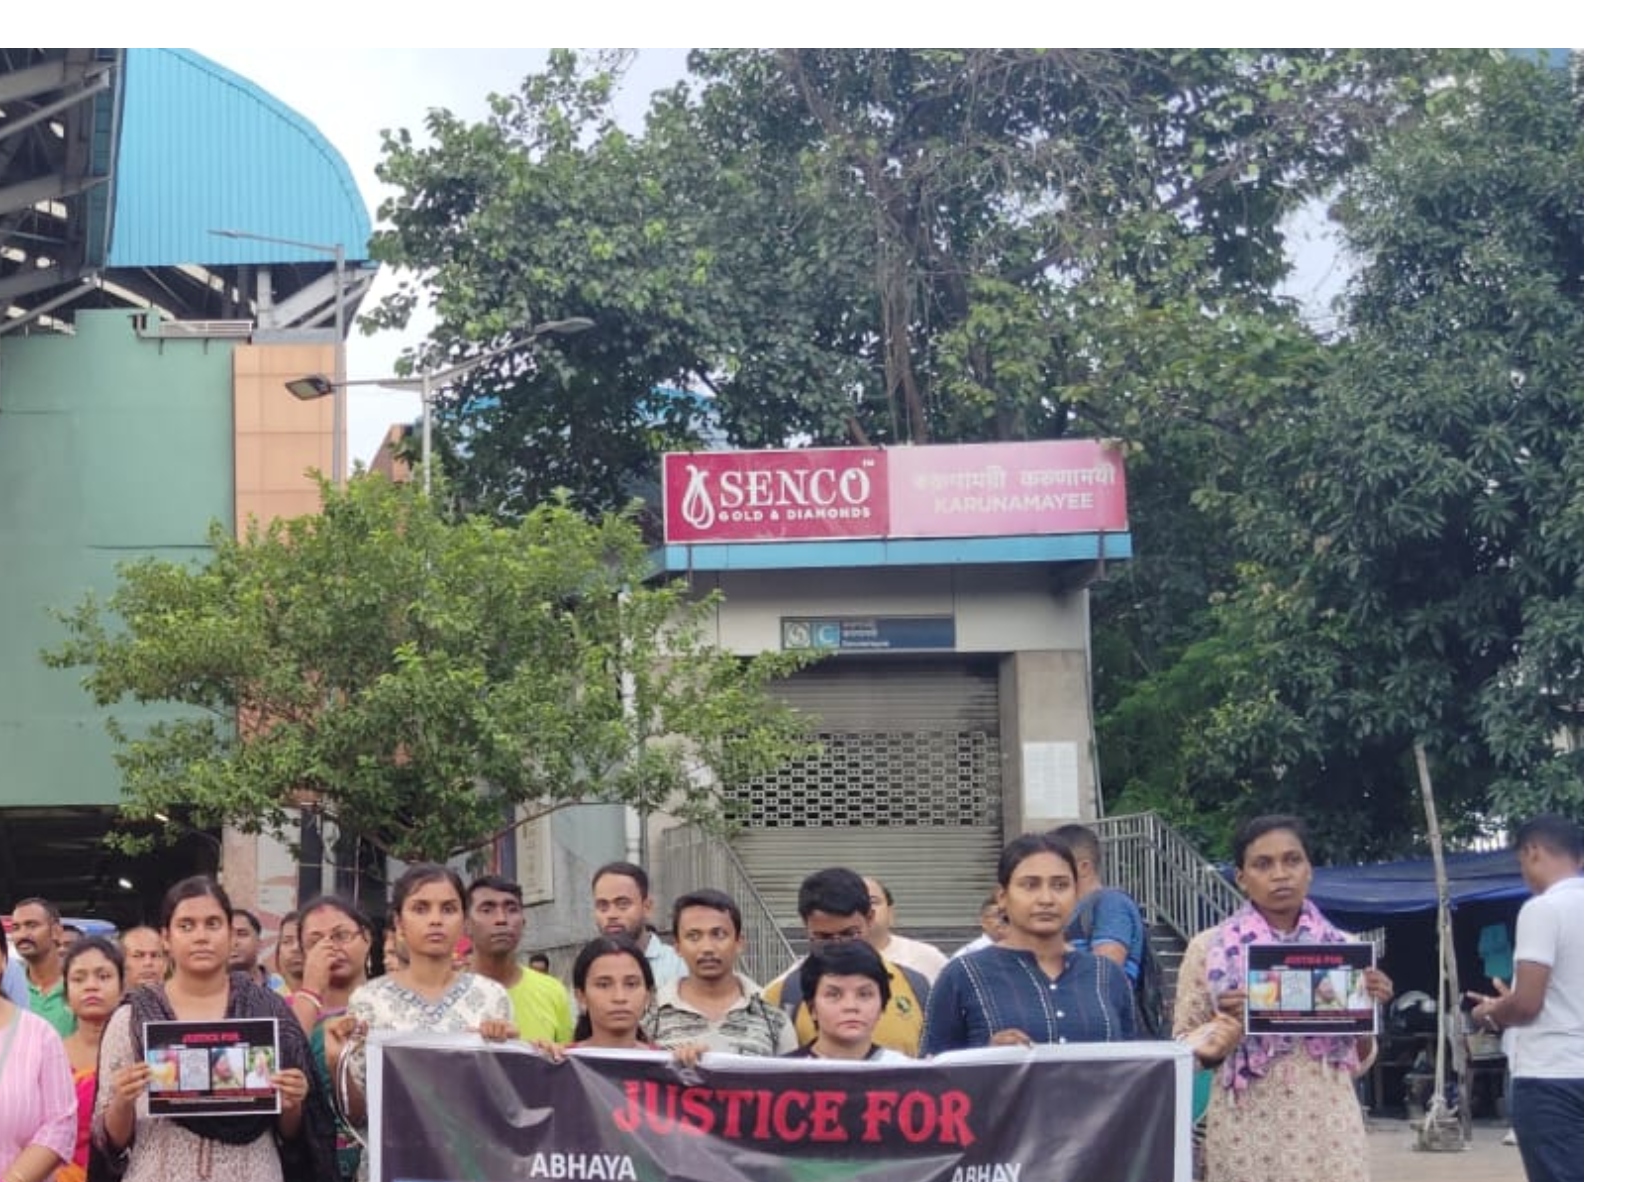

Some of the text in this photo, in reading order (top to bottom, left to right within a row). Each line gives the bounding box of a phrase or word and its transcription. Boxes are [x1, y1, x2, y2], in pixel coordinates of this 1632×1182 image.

[720, 467, 870, 508] SENCO
[718, 506, 872, 522] GOLD & DIAMONDS
[934, 492, 1094, 514] KARUNAMAYEE
[613, 1080, 976, 1147] JUSTICE FOR
[530, 1153, 636, 1182] ABHAYA
